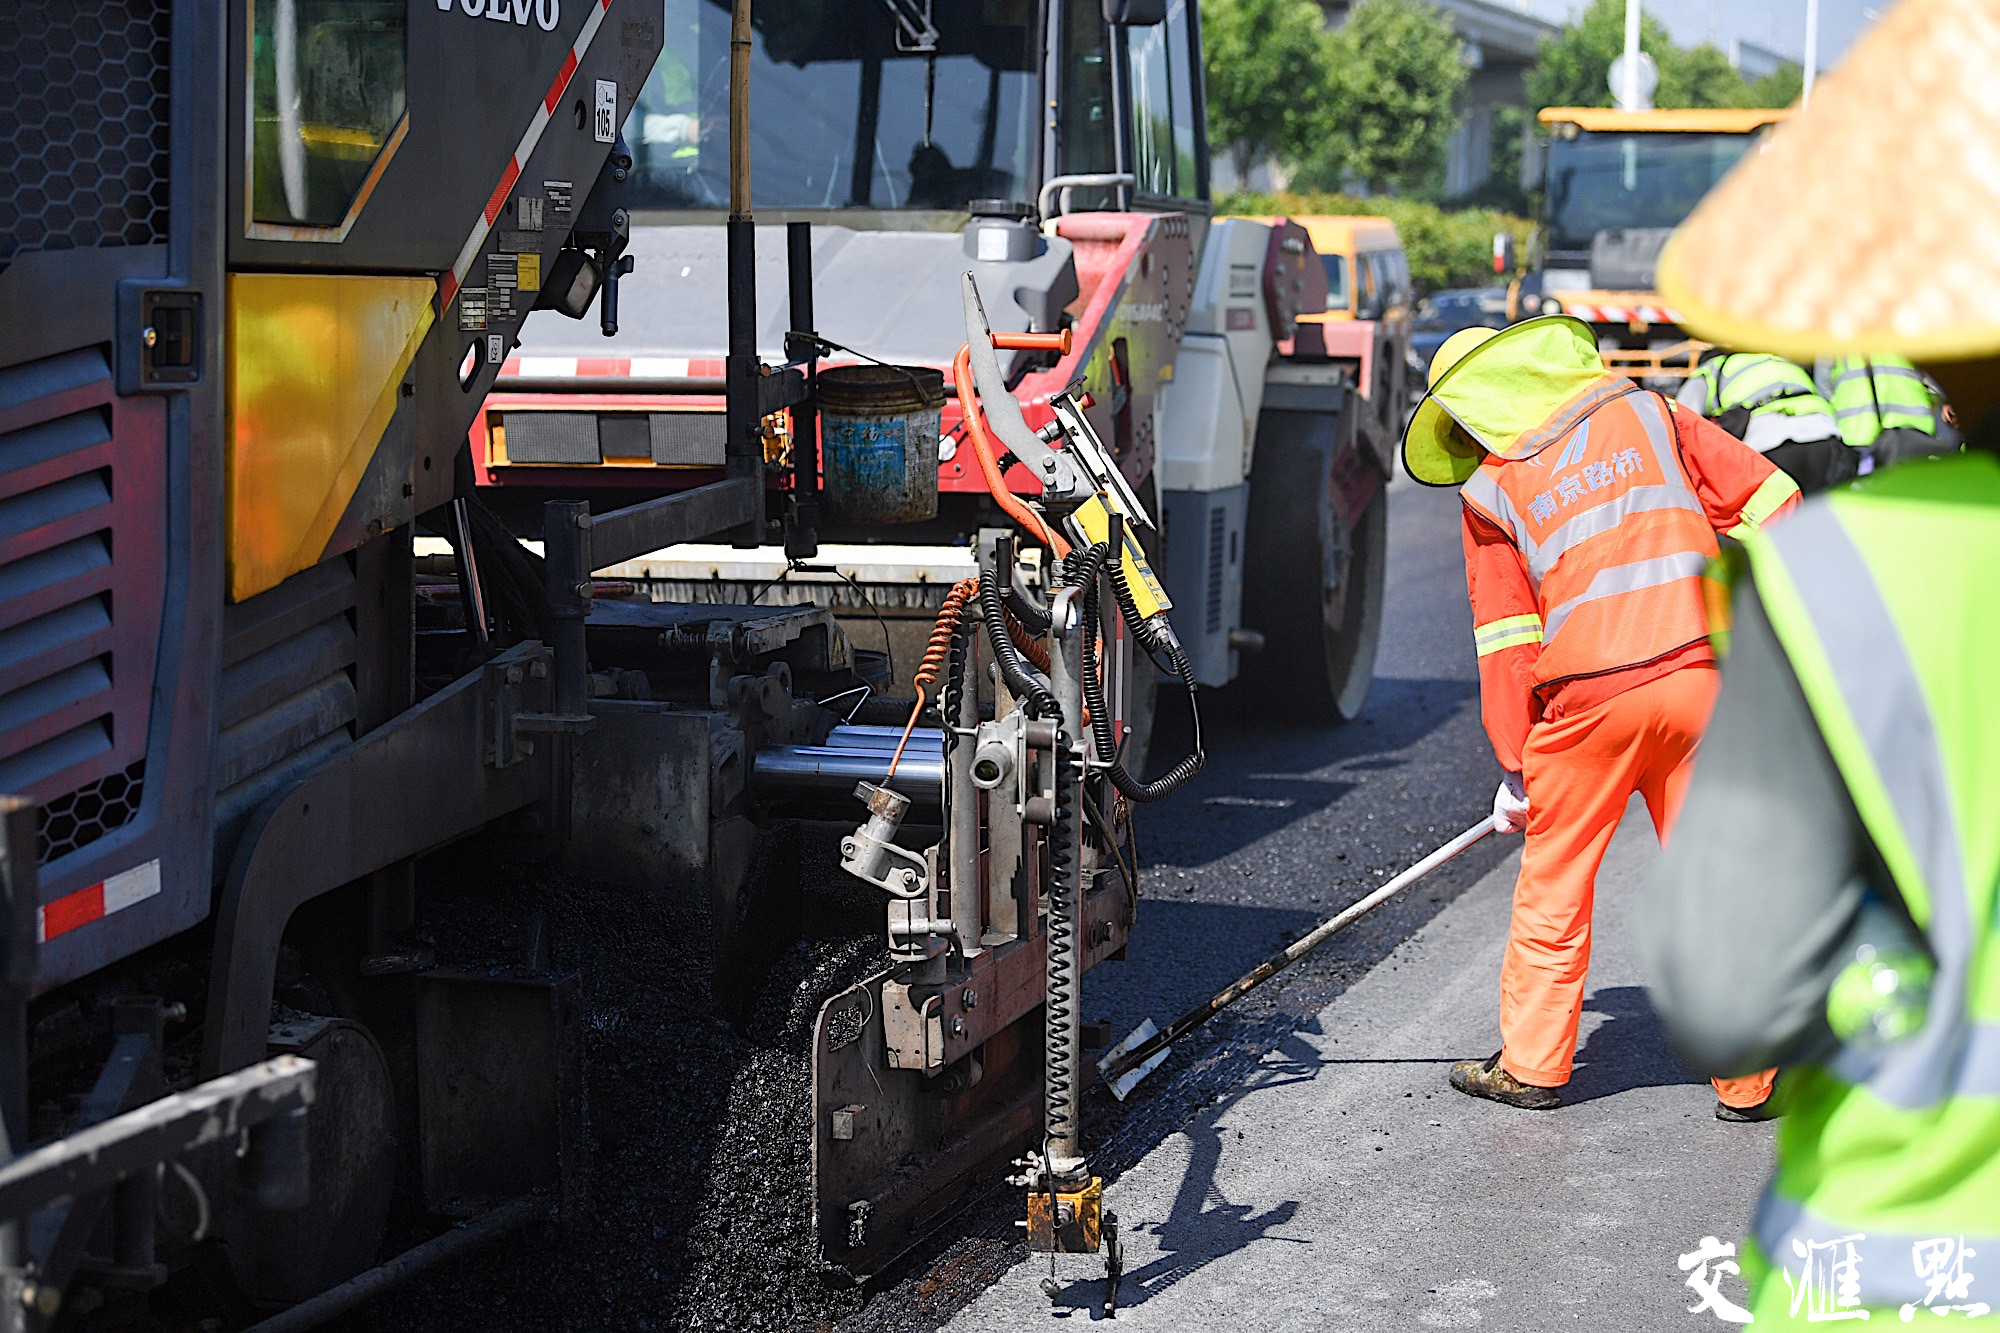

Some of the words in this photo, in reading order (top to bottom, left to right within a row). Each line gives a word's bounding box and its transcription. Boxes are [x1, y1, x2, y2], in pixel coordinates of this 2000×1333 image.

[436, 0, 560, 31] LVO
[596, 107, 611, 137] 105
[1527, 447, 1644, 527] 南京路桥
